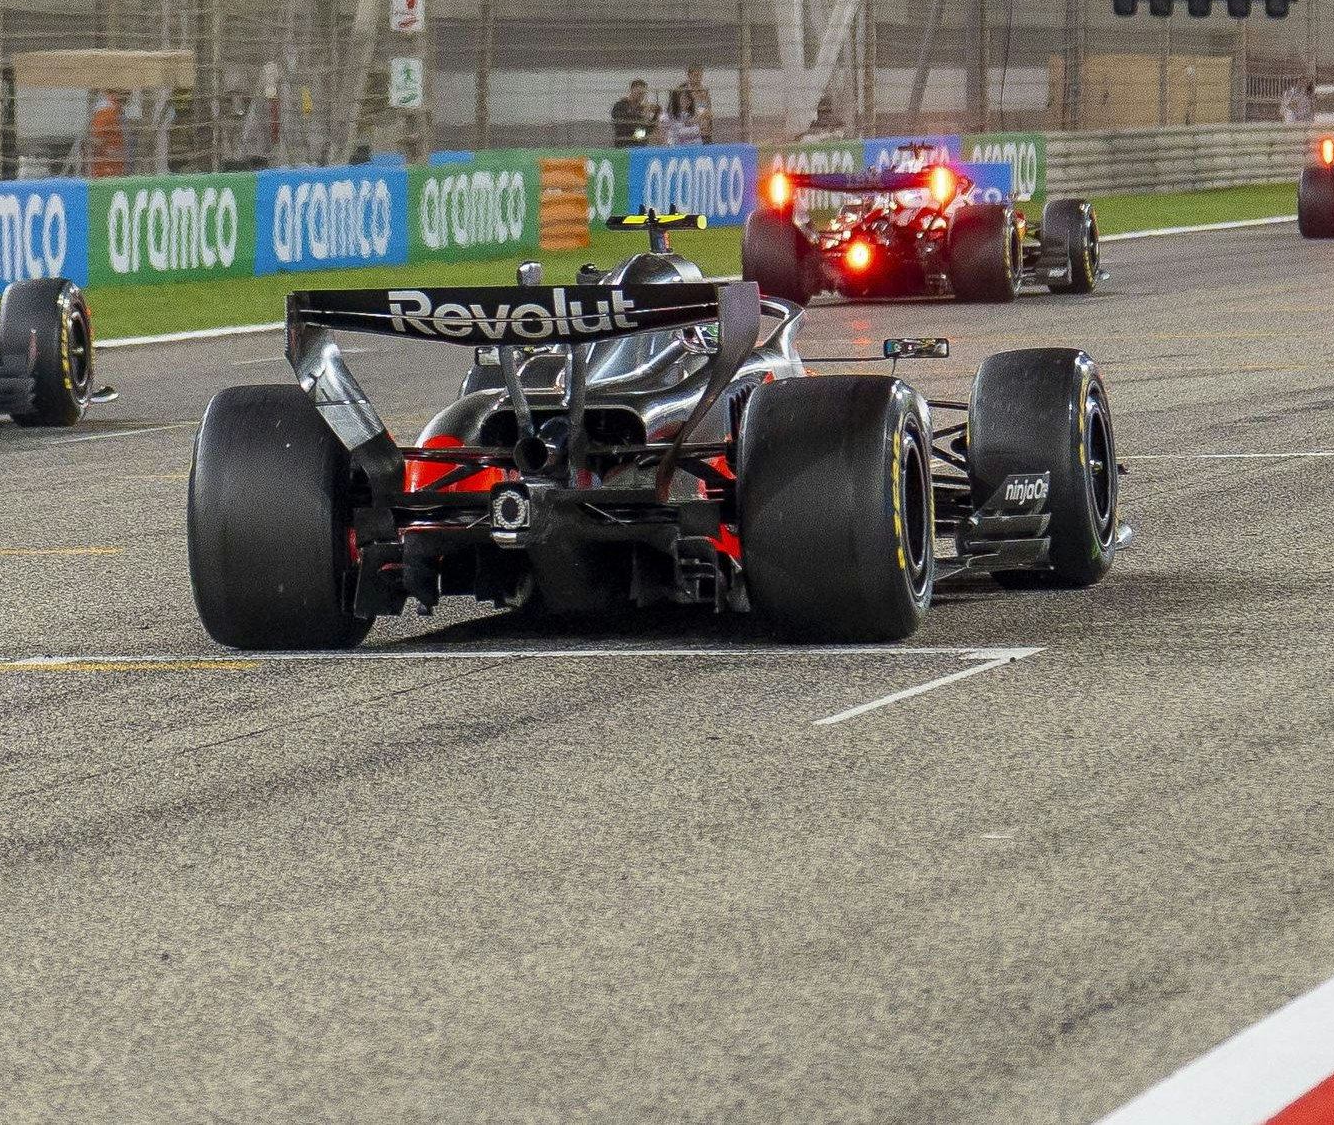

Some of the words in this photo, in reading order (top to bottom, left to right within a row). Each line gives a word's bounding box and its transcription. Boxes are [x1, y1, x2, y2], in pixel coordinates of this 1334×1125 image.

[273, 178, 392, 263] aramco
[420, 171, 526, 250] aramco
[644, 157, 745, 221] aramco
[107, 187, 237, 273] aramco
[387, 287, 639, 340] Revolut
